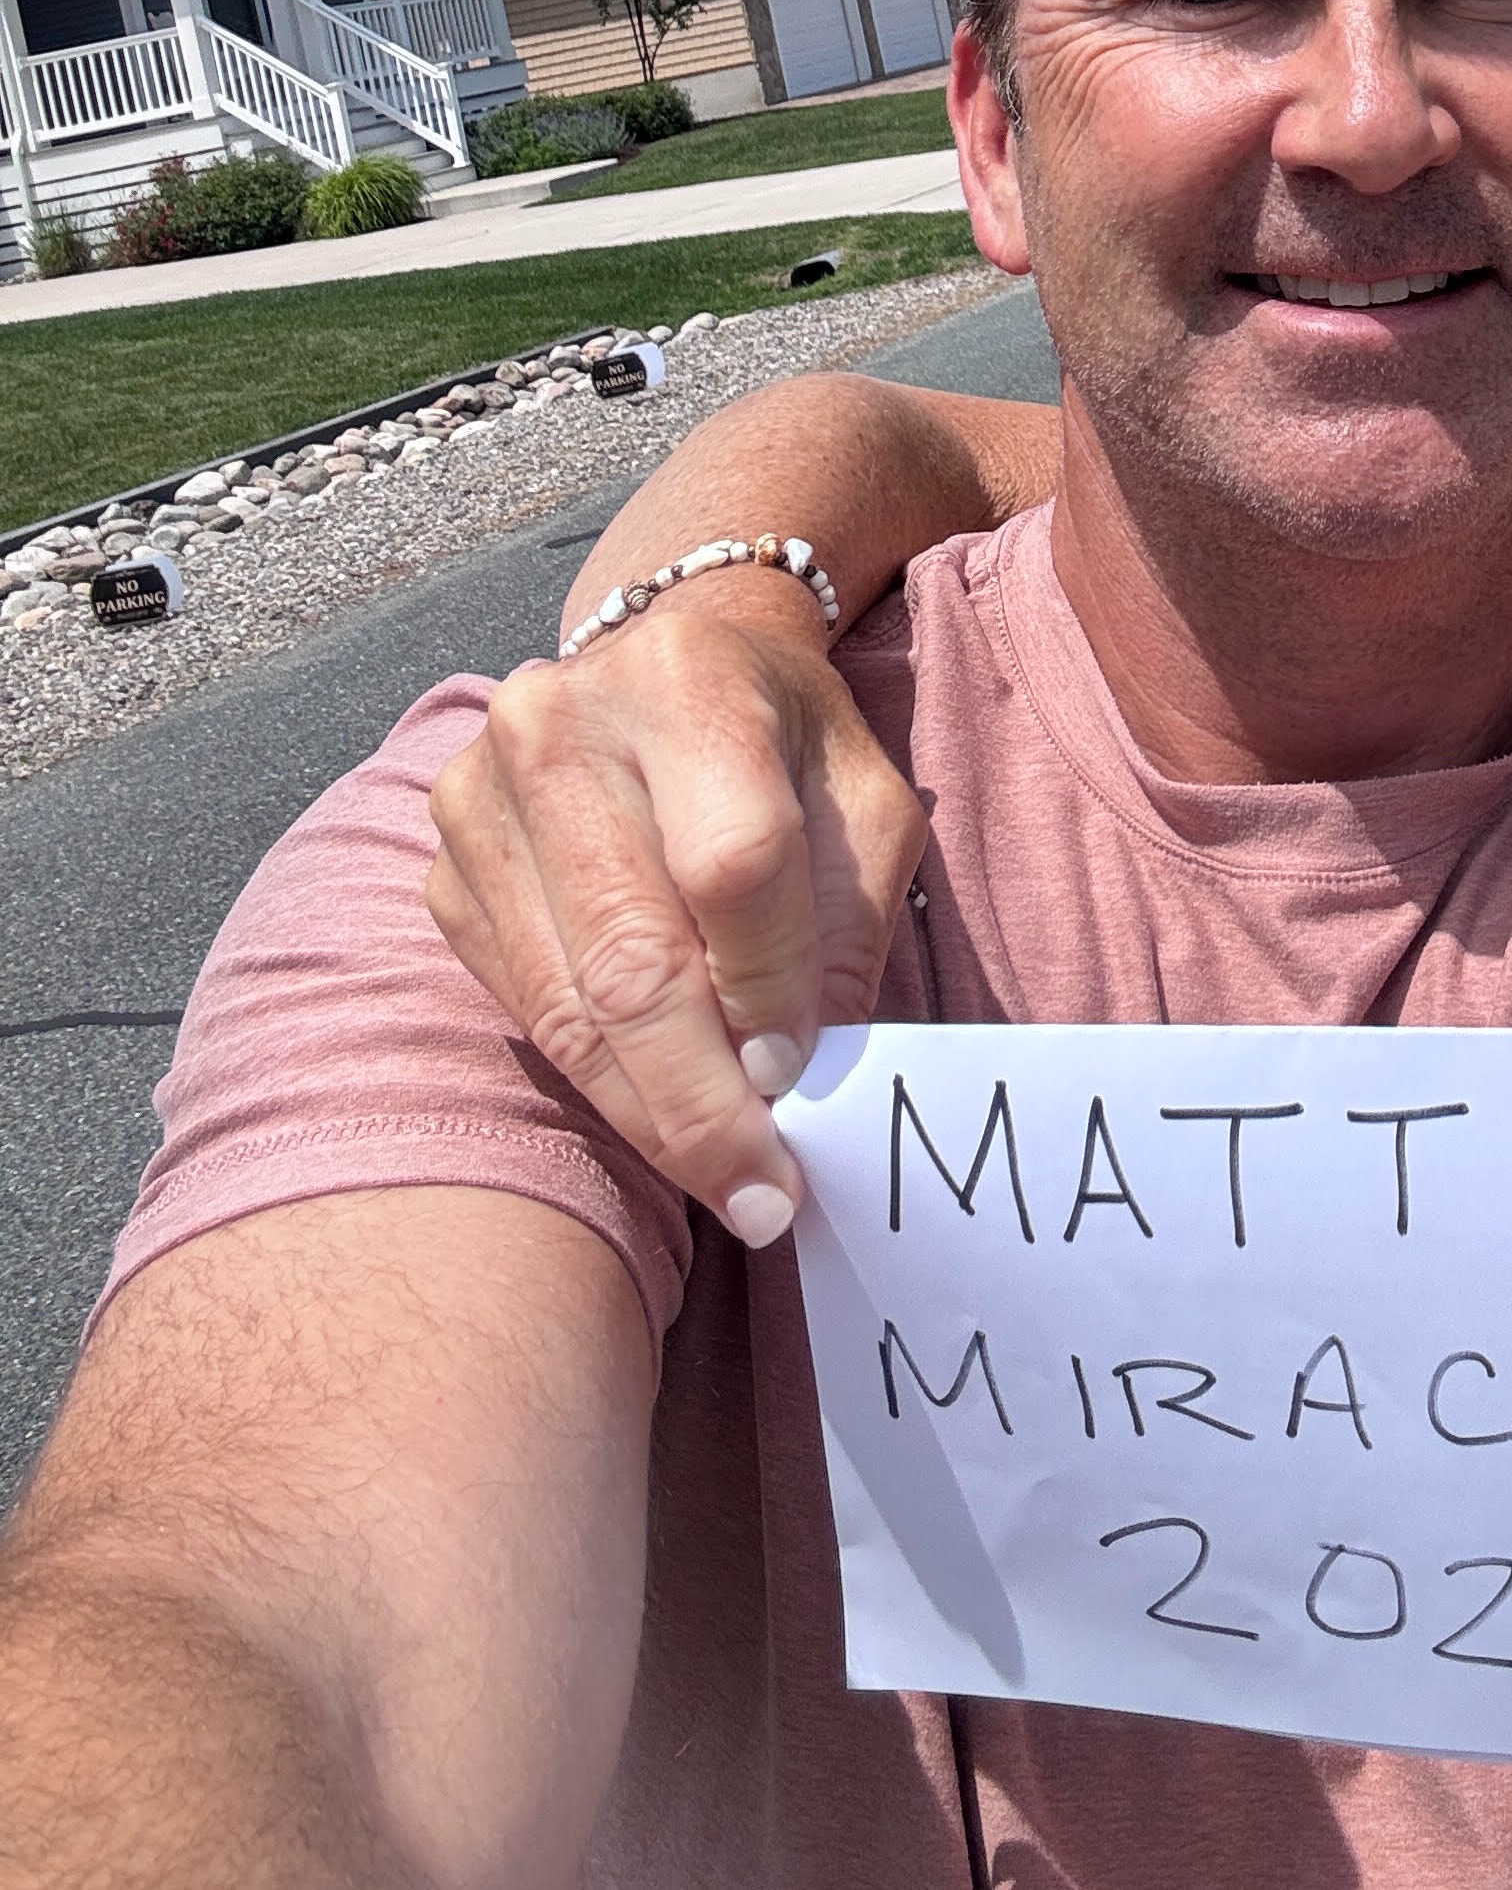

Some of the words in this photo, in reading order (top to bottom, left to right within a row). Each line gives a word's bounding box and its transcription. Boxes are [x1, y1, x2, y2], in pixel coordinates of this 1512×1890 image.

[608, 363, 625, 375] NO
[116, 579, 139, 595] NO
[96, 592, 166, 614] PARKING
